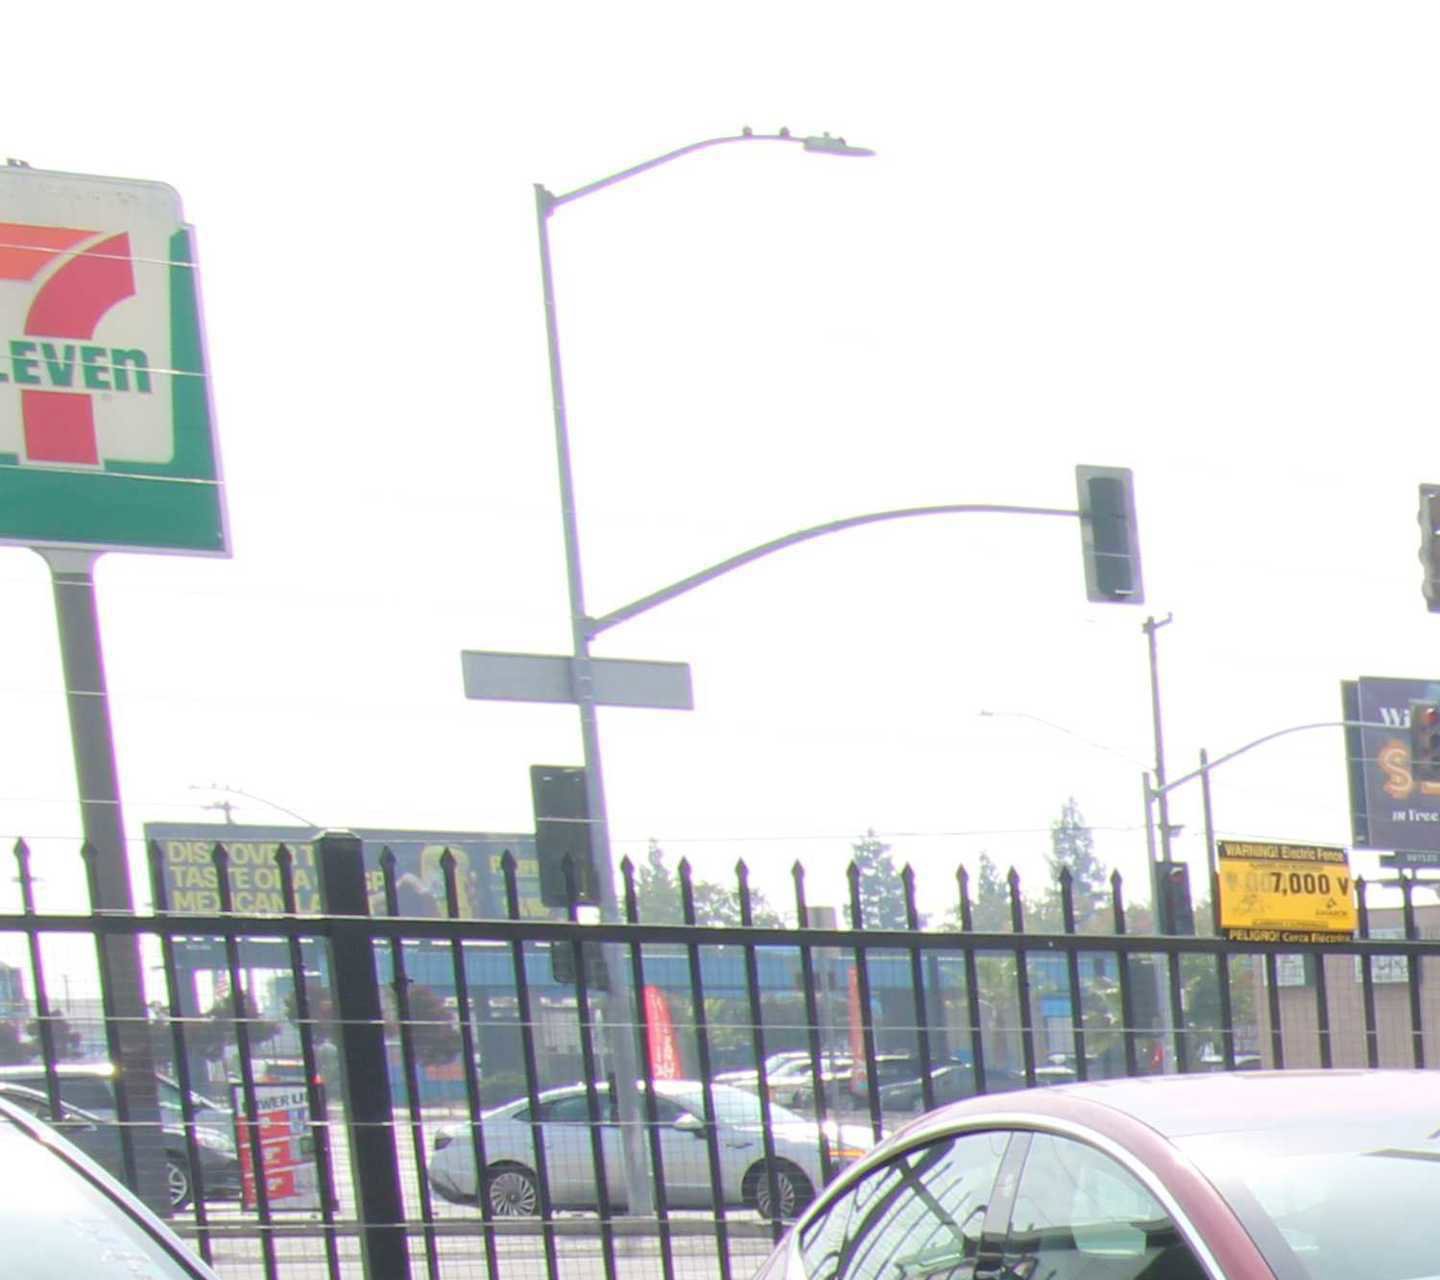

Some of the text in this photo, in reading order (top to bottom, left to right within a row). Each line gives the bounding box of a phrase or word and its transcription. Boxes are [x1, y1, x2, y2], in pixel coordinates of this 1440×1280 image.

[0, 340, 152, 394] EVEn
[1271, 872, 1349, 897] 7,000 V
